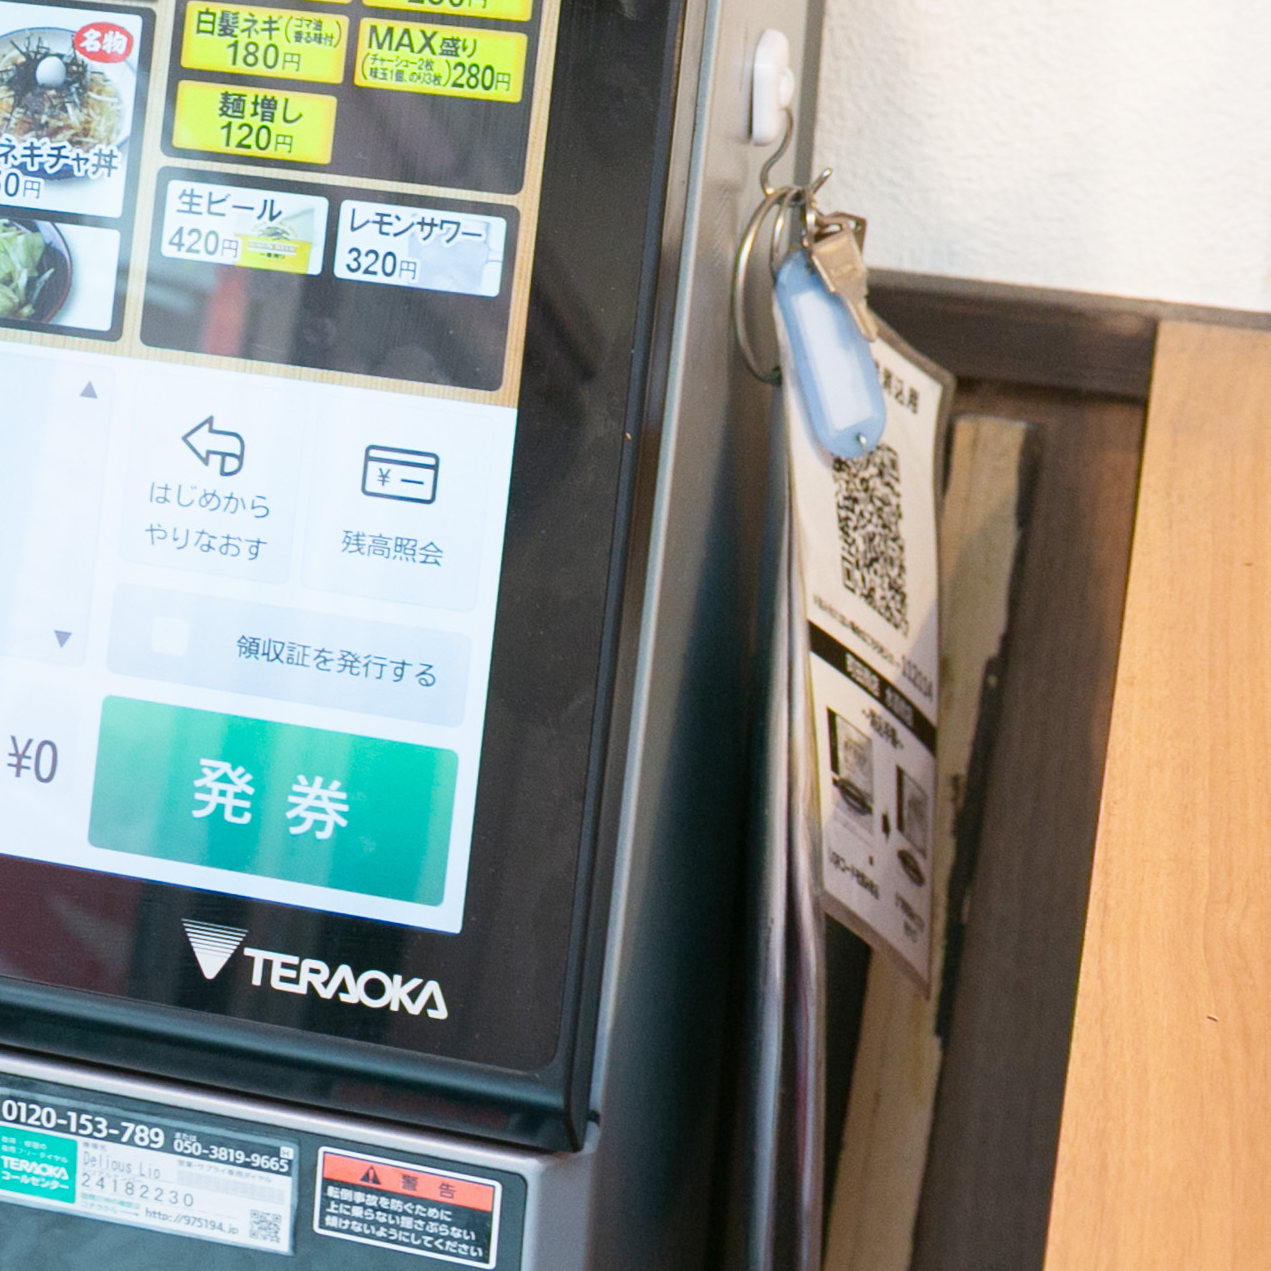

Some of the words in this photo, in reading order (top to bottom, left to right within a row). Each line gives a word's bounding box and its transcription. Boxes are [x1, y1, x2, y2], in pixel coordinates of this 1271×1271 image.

[79, 29, 128, 55] 名物
[227, 40, 301, 71] 180円
[368, 25, 477, 57] MAX盛り
[451, 62, 511, 91] 280円
[219, 92, 303, 124] 麺増し
[220, 121, 294, 154] 120円
[176, 188, 282, 222] 生ビール
[168, 226, 239, 259] 420円
[350, 207, 484, 244] レモンサワー
[346, 247, 418, 281] 320円
[148, 481, 271, 520] はじめから
[145, 523, 268, 561] やりなおす
[341, 530, 444, 567] 残高照会
[237, 635, 437, 688] 領収証を発行する
[191, 757, 349, 840] 発券
[243, 947, 448, 1020] TERAOKA
[1, 1099, 165, 1149] 0120-153-789
[0, 1155, 69, 1180] TERAOKA
[83, 1151, 132, 1174] Delious
[173, 1139, 289, 1172] 050-3819-9665
[1, 1170, 69, 1190] コールセンター
[326, 1185, 452, 1222] 転倒事故を防ぐために
[325, 1201, 476, 1241] 上に乗らない揺さぶらない
[325, 1215, 483, 1258] 傾けないようにしてください
